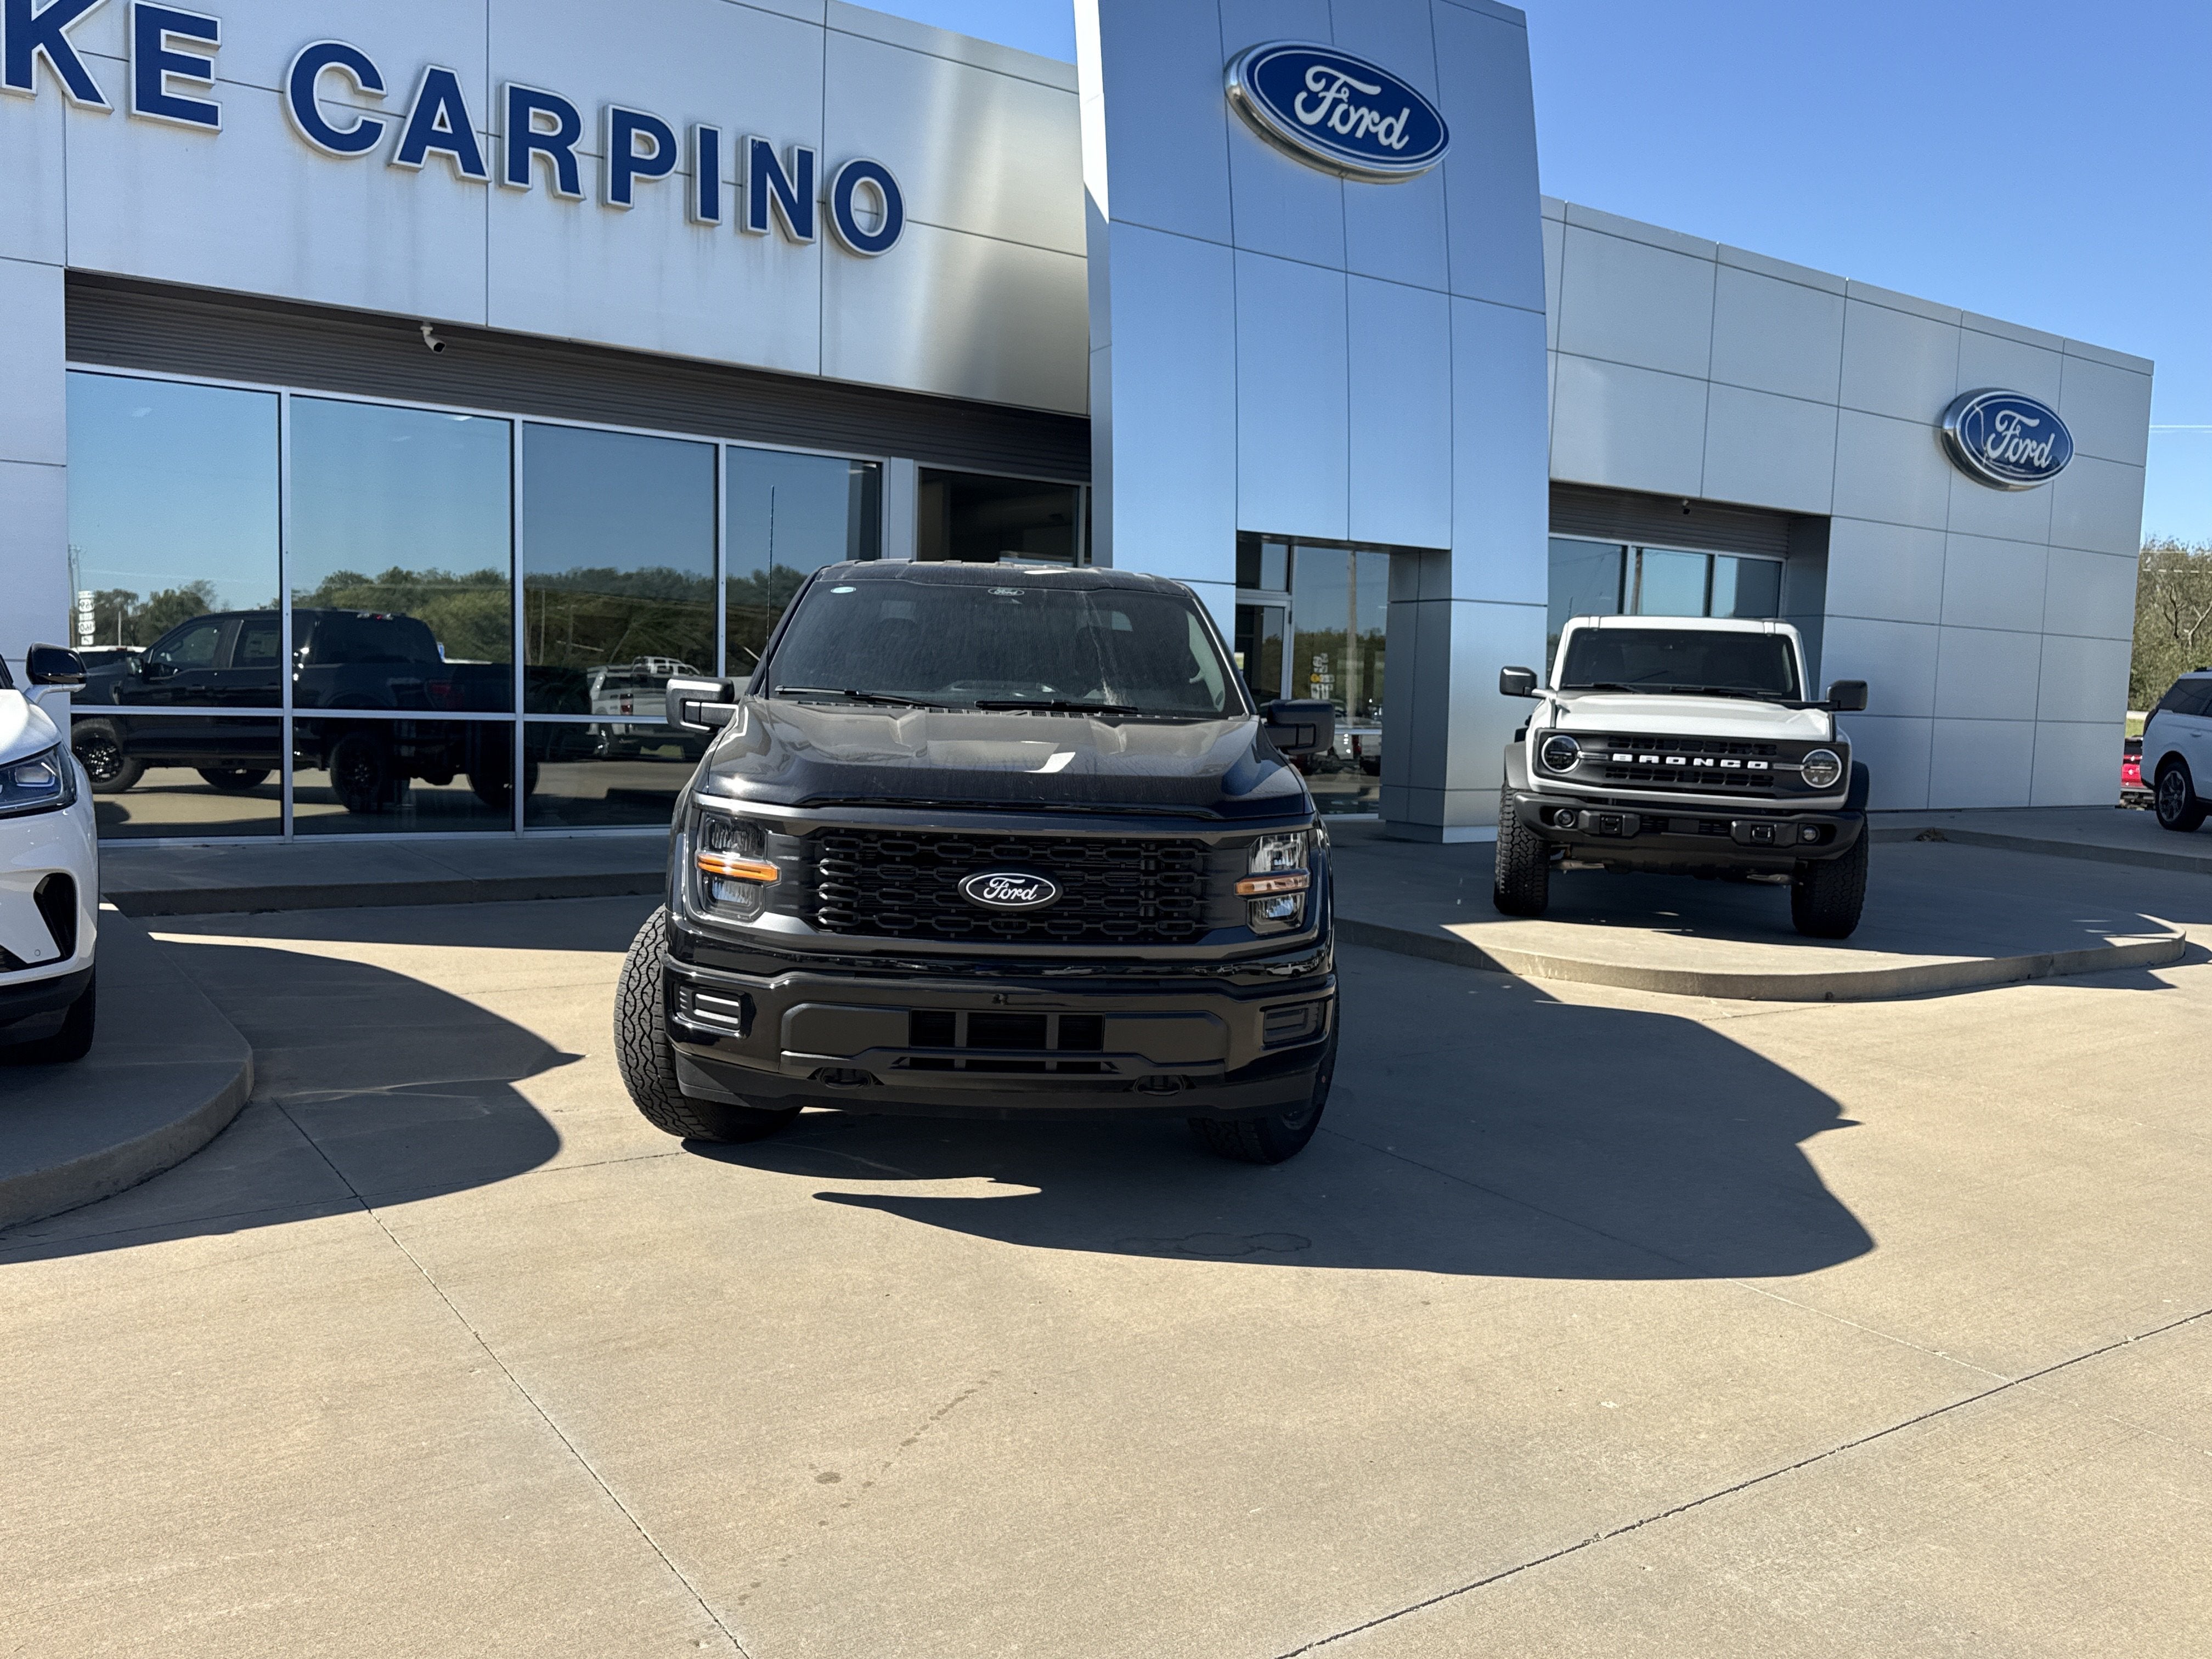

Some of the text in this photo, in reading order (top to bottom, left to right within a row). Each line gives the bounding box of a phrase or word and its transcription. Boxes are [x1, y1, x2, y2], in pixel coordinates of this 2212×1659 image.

[1294, 65, 1410, 150] Ford
[284, 39, 906, 257] CARPINO
[1985, 410, 2055, 468] Ford
[1612, 753, 1768, 770] BRONCO
[984, 877, 1039, 900] Ford
